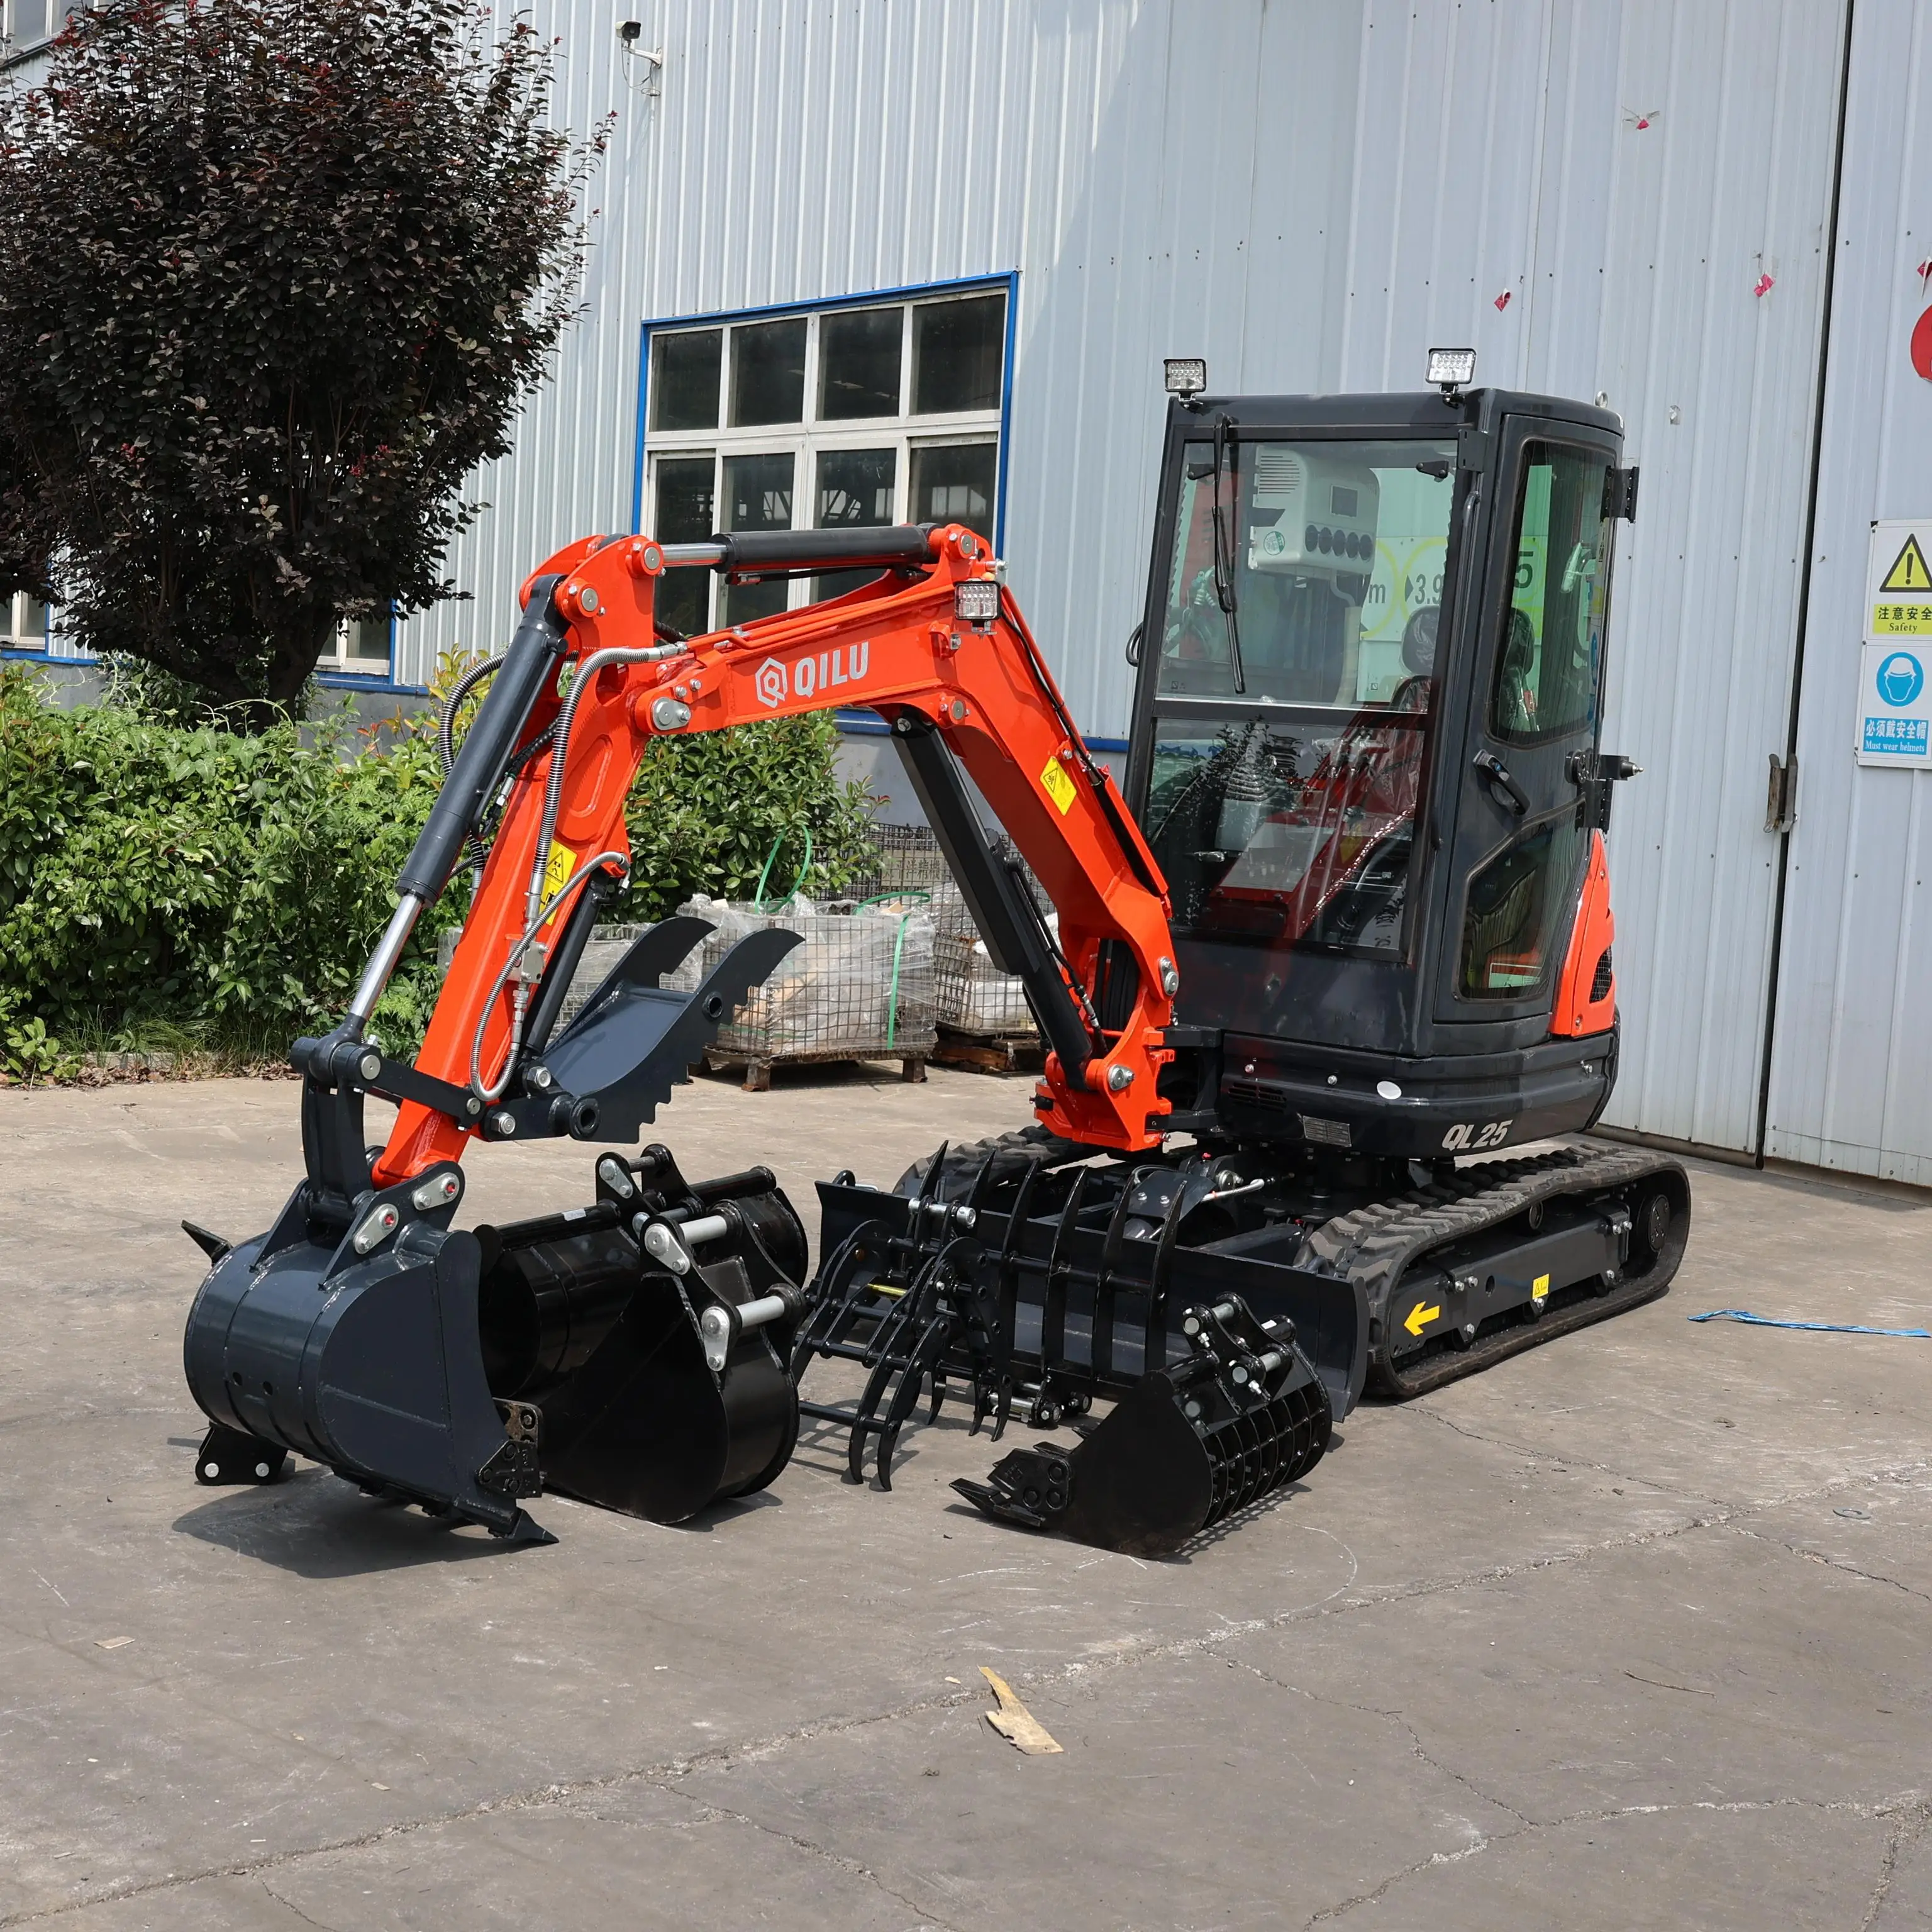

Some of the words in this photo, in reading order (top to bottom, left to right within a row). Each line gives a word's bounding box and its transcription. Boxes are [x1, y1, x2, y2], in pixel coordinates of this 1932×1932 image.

[1878, 606, 1932, 620] 注意安全
[1889, 622, 1918, 634] Safety
[794, 641, 869, 698] QILU
[1865, 719, 1927, 740] 必须戴安全帽
[1865, 740, 1882, 750] Must
[1882, 743, 1898, 751] wear
[1899, 741, 1924, 753] helmets
